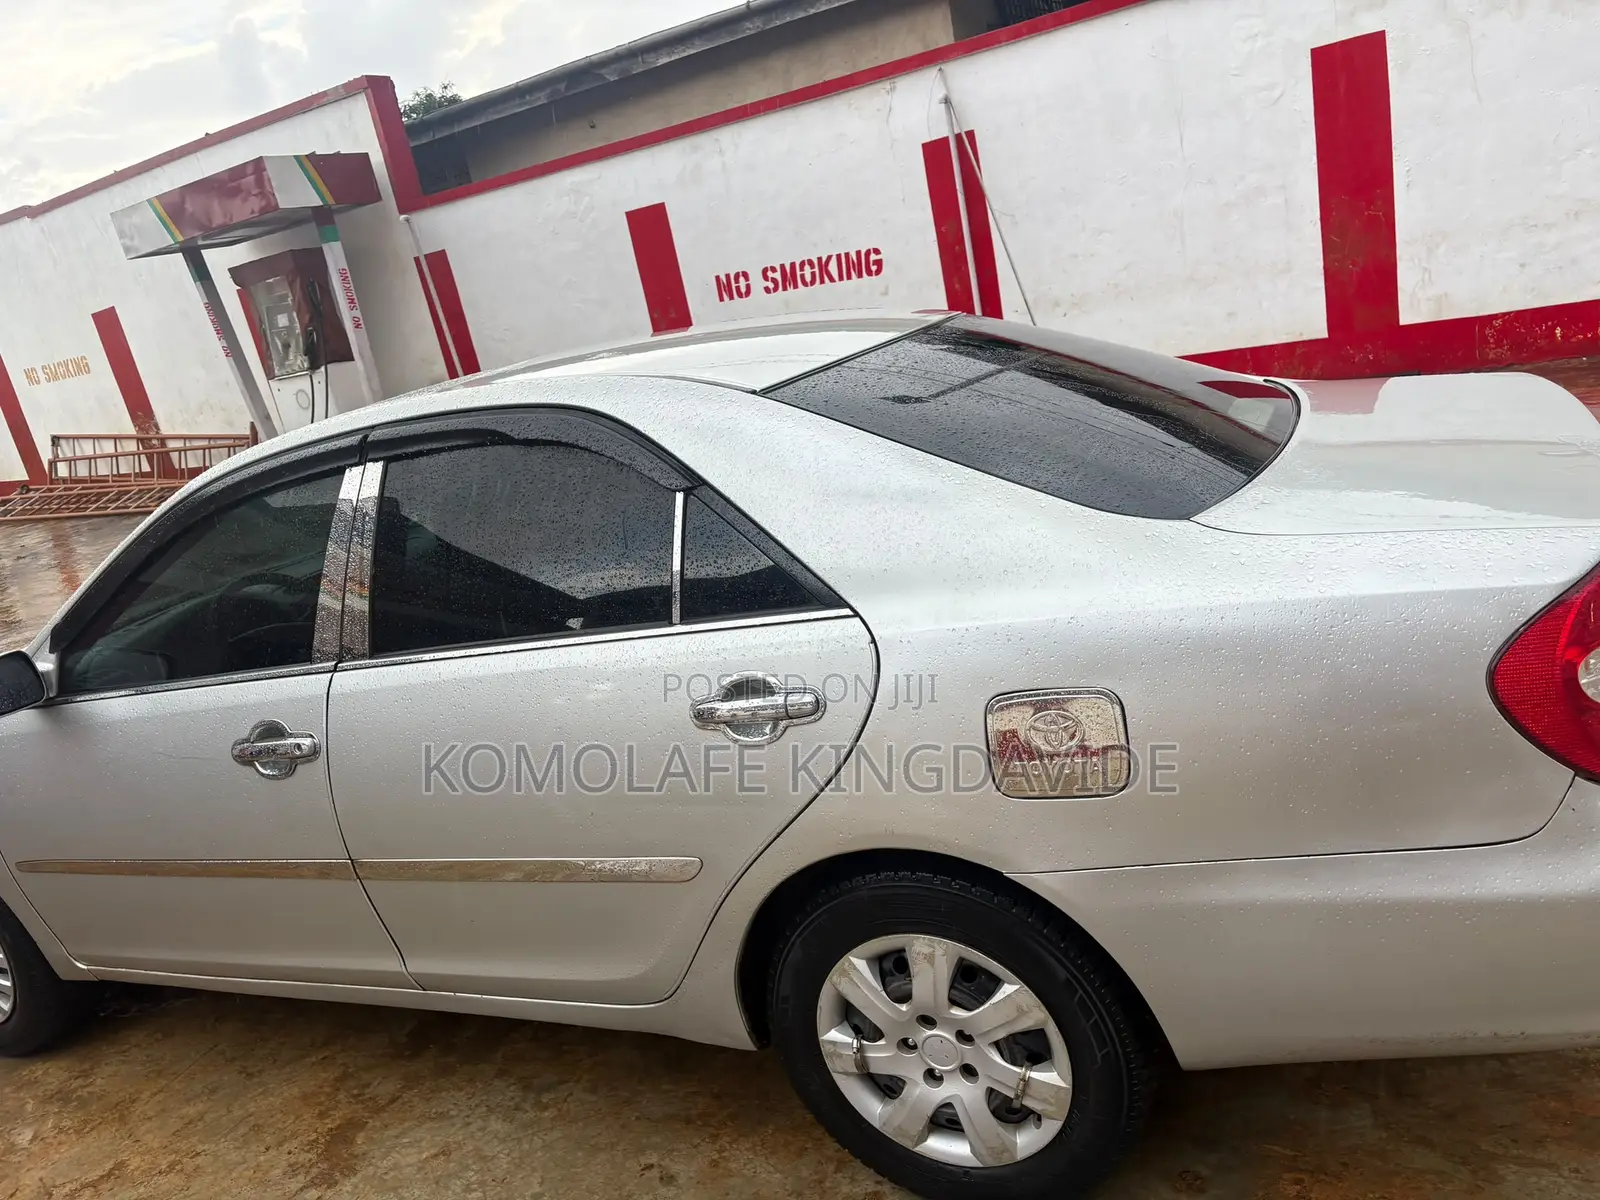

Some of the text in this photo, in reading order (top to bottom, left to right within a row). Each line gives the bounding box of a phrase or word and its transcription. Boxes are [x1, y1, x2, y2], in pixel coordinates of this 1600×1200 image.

[714, 247, 883, 303] NO SMOKING
[338, 267, 363, 329] NO SMOKING
[221, 345, 232, 358] NO
[23, 355, 91, 386] NO SMOKING
[1014, 758, 1101, 777] TOYOTA
